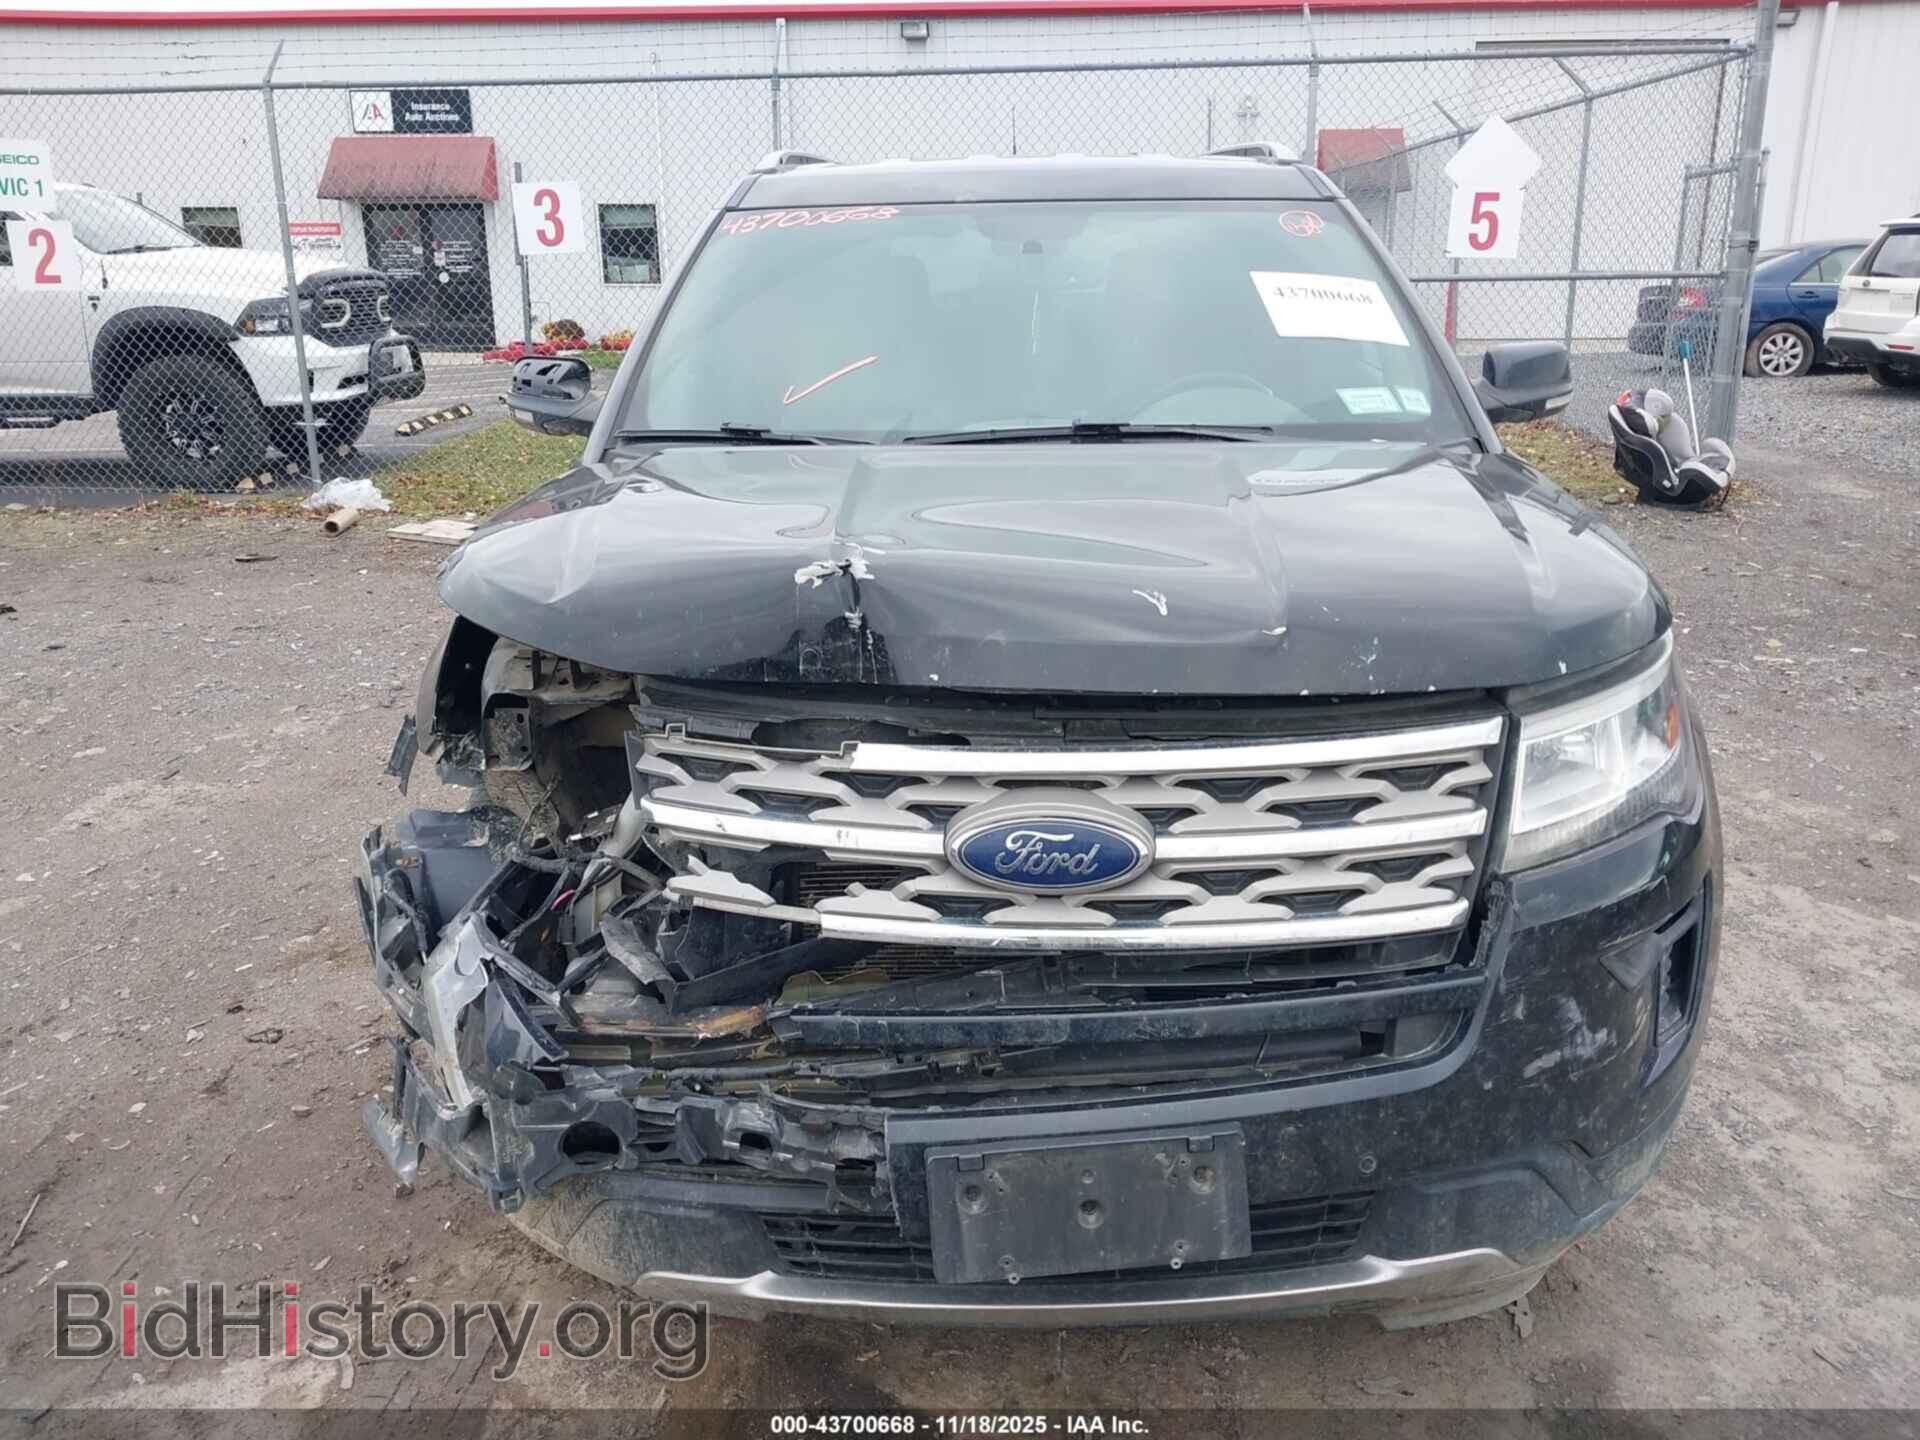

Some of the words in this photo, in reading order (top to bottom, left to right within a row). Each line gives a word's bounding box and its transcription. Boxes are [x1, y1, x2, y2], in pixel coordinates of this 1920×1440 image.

[405, 112, 423, 121] Auto
[425, 112, 460, 121] Auctions
[411, 102, 450, 111] Insurance
[0, 154, 39, 165] EICO
[34, 178, 43, 197] 1
[533, 188, 564, 247] 3
[1468, 192, 1500, 251] 5
[28, 228, 62, 283] 2
[995, 830, 1101, 874] Ford
